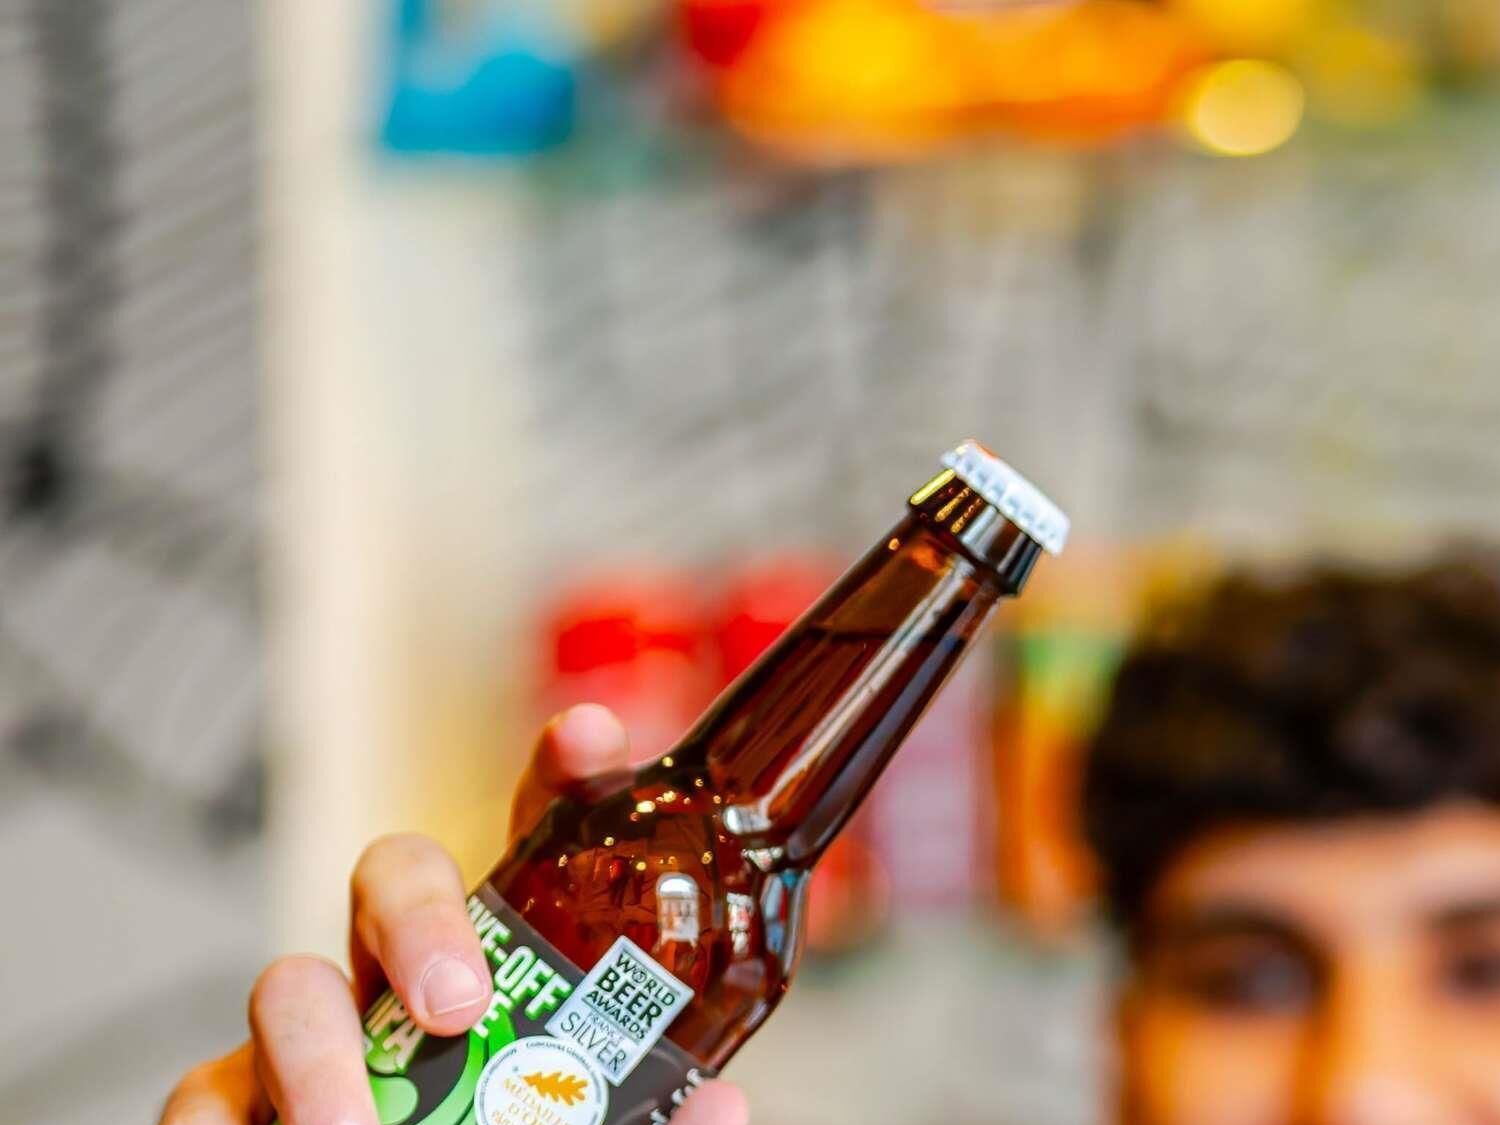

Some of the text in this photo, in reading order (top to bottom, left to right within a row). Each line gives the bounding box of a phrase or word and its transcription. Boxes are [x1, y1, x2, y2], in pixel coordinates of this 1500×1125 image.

[595, 965, 662, 1028] BEER
[615, 953, 676, 1007] WORLD
[560, 1011, 627, 1072] SILVER
[586, 990, 646, 1040] AWARDS
